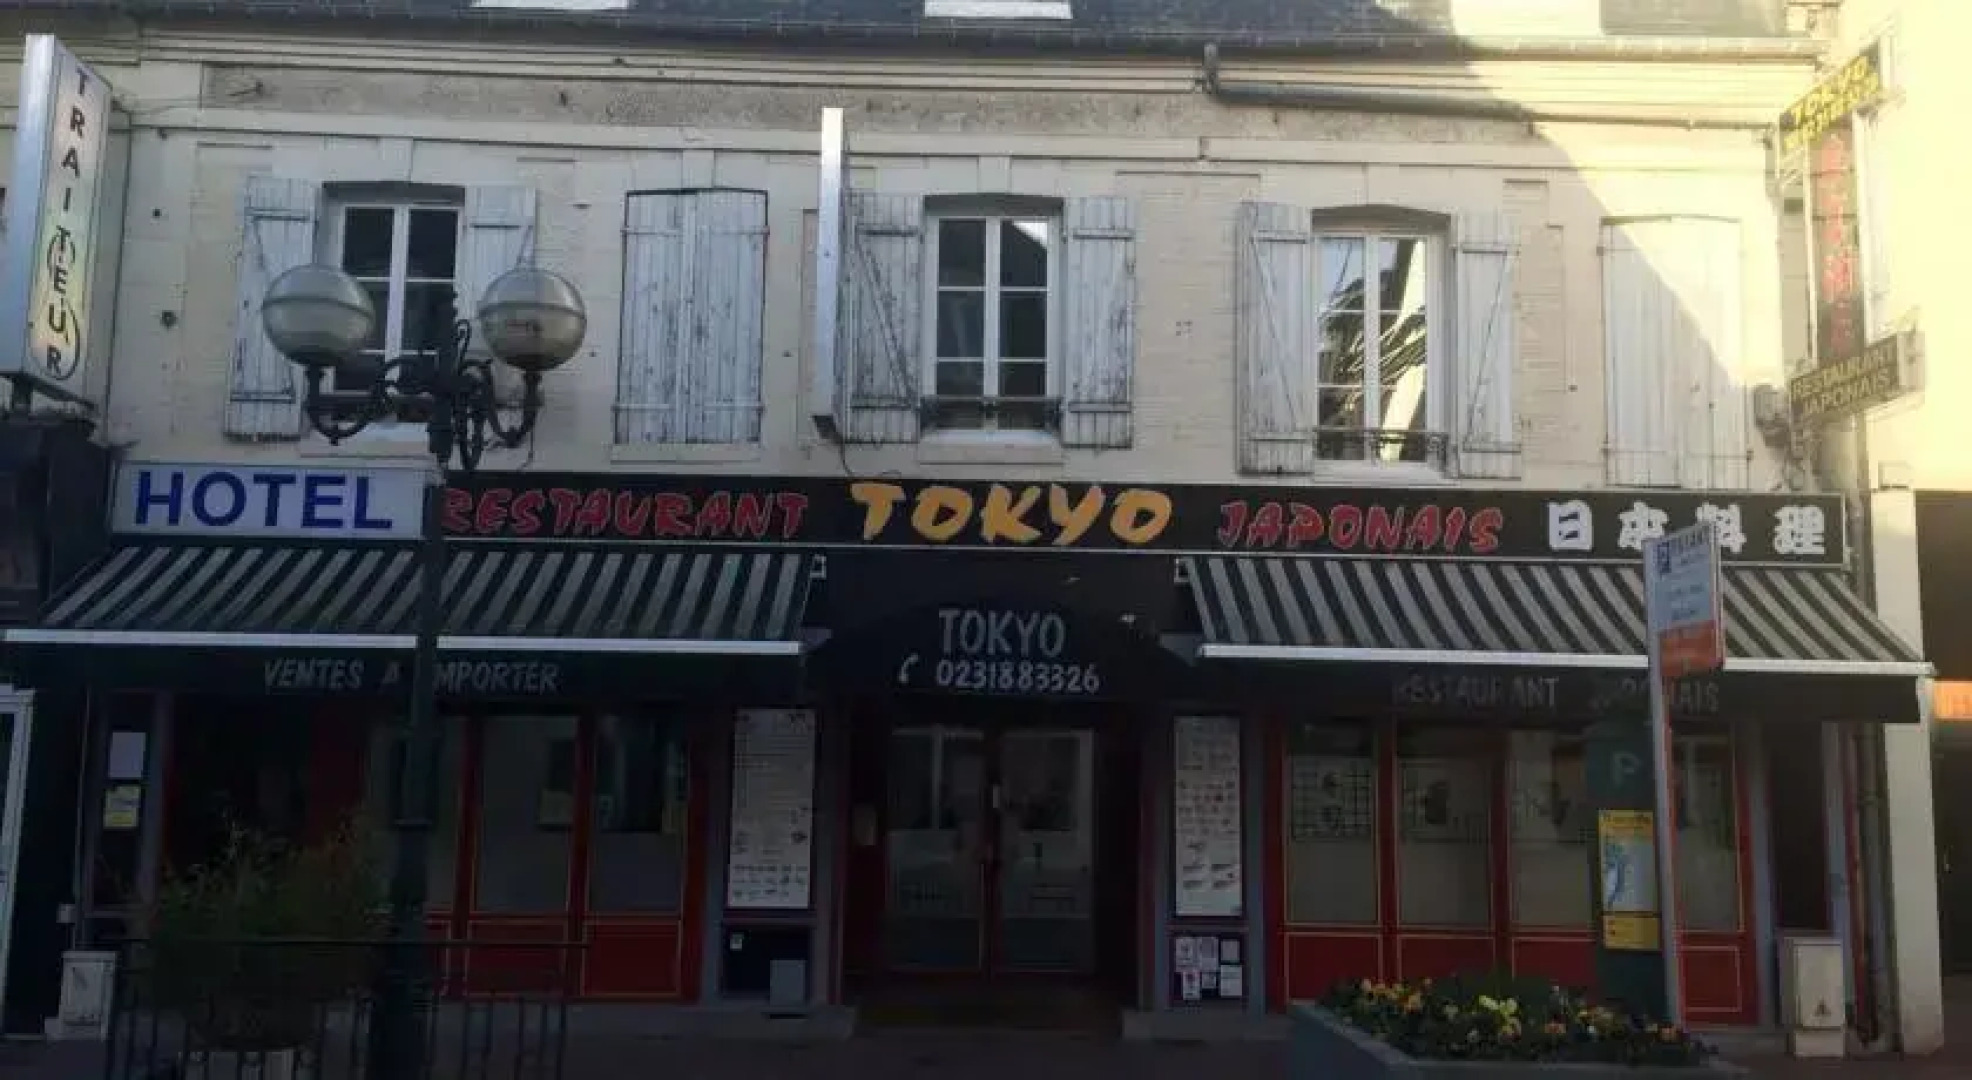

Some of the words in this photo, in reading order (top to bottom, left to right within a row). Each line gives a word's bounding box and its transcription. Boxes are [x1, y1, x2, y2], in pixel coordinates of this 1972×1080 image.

[45, 67, 88, 376] TRAITEUR
[135, 471, 393, 529] HOTEL
[441, 487, 808, 539] RESTAURANT
[851, 482, 1172, 545] TOKYO
[1218, 500, 1503, 552] JAPONAIS
[938, 608, 1066, 657] TOKYO
[264, 657, 364, 690] VENTES
[433, 661, 558, 694] MPORTER
[934, 659, 1099, 693] 0231883326
[1614, 751, 1641, 785] P
